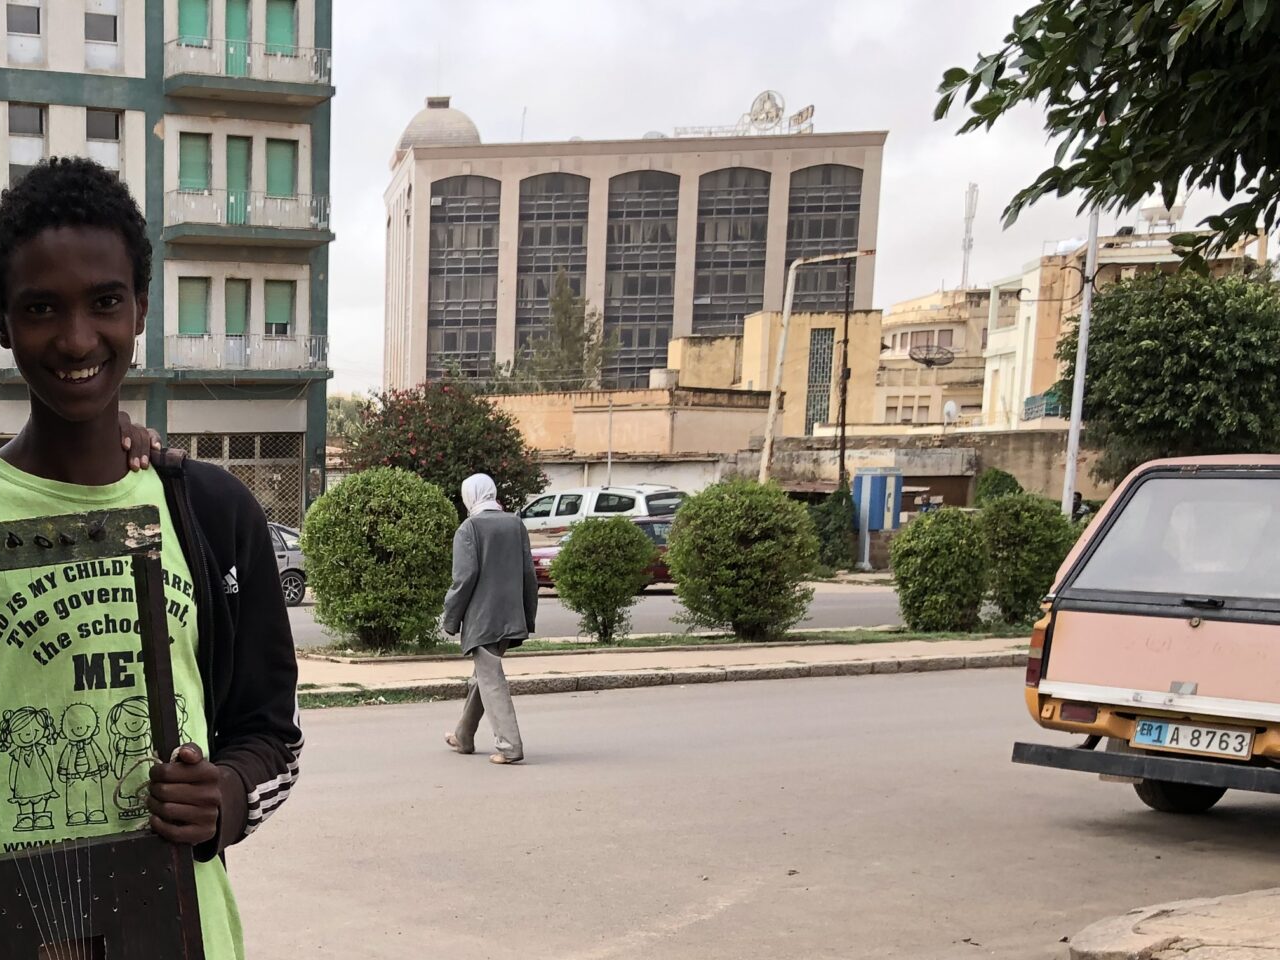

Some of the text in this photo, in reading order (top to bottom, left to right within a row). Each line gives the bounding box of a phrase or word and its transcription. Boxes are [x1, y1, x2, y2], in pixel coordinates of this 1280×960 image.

[8, 591, 28, 617] IS
[27, 573, 58, 599] MY
[6, 585, 190, 650] The governnt,
[32, 630, 73, 667] the
[1169, 726, 1180, 746] A
[1189, 728, 1246, 752] 8763
